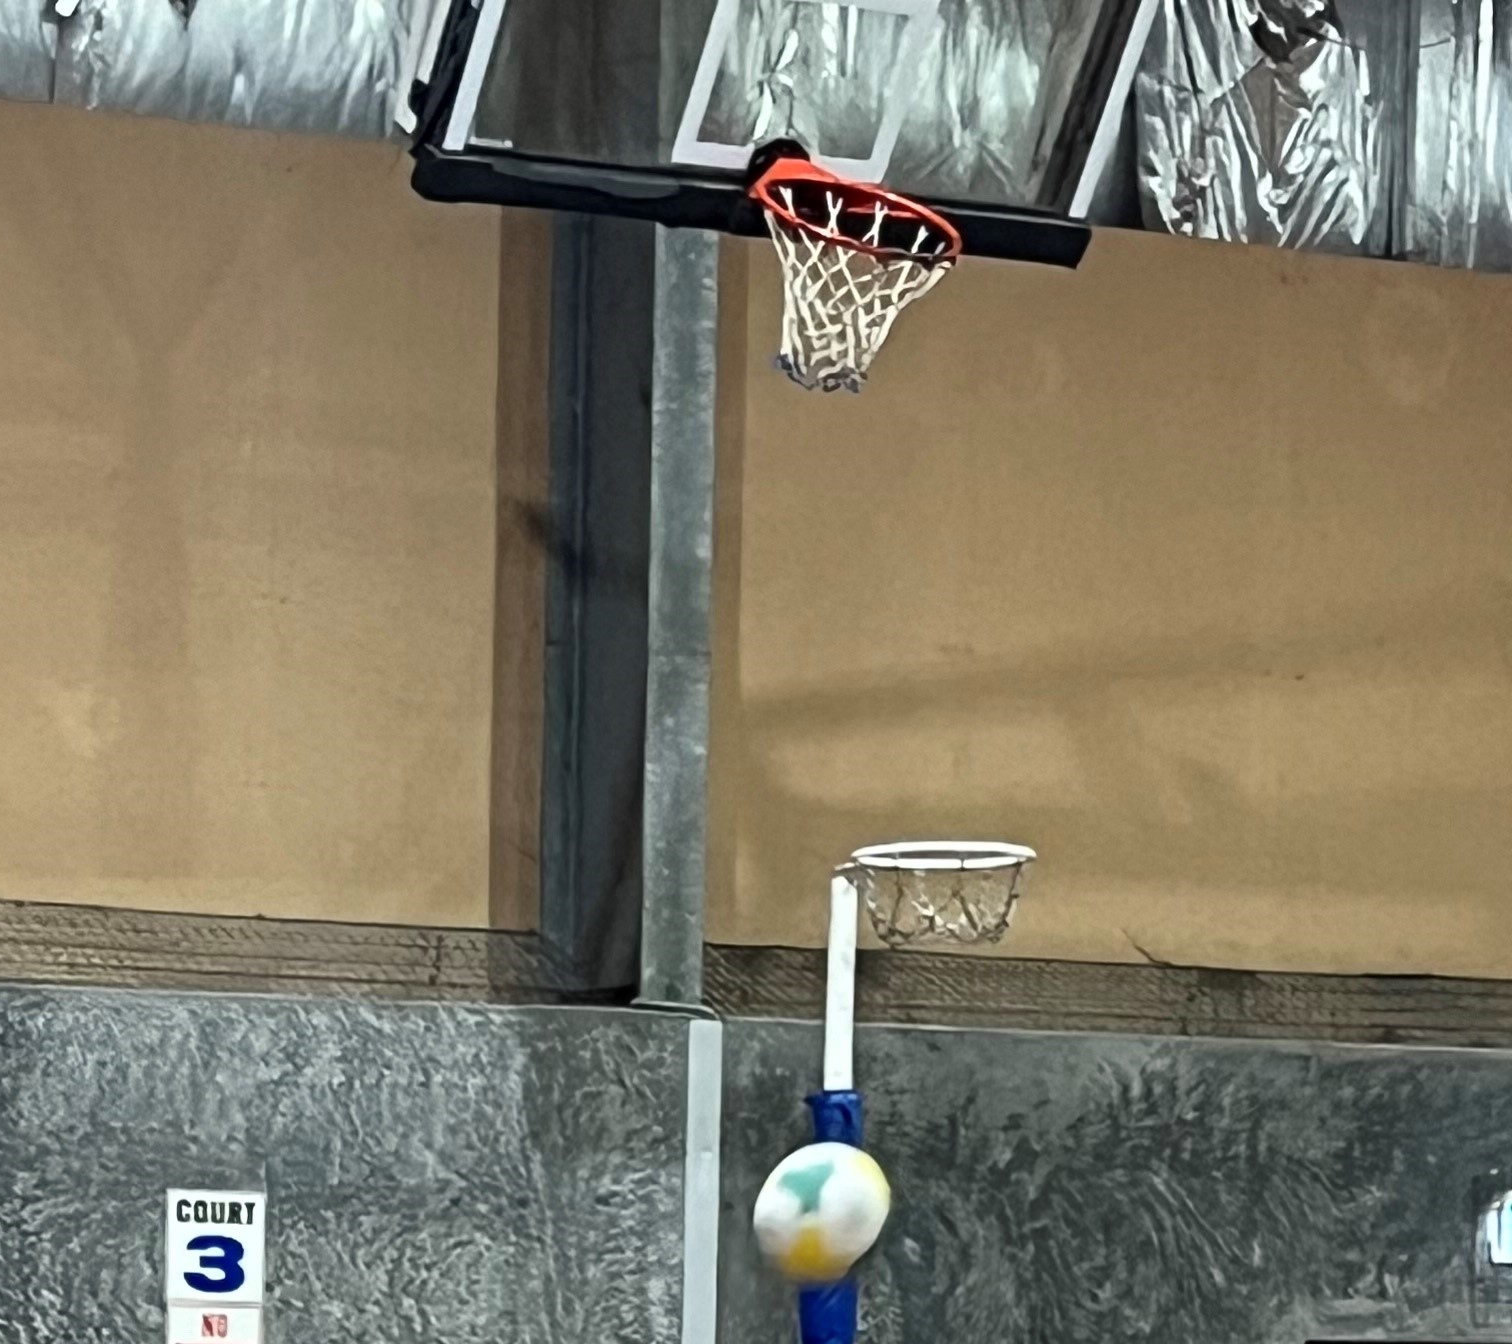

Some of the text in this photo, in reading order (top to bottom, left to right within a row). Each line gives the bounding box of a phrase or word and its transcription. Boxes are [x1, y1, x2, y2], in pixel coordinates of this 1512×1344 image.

[176, 1199, 255, 1225] COURT
[183, 1235, 245, 1293] 3
[202, 1313, 228, 1338] NO
